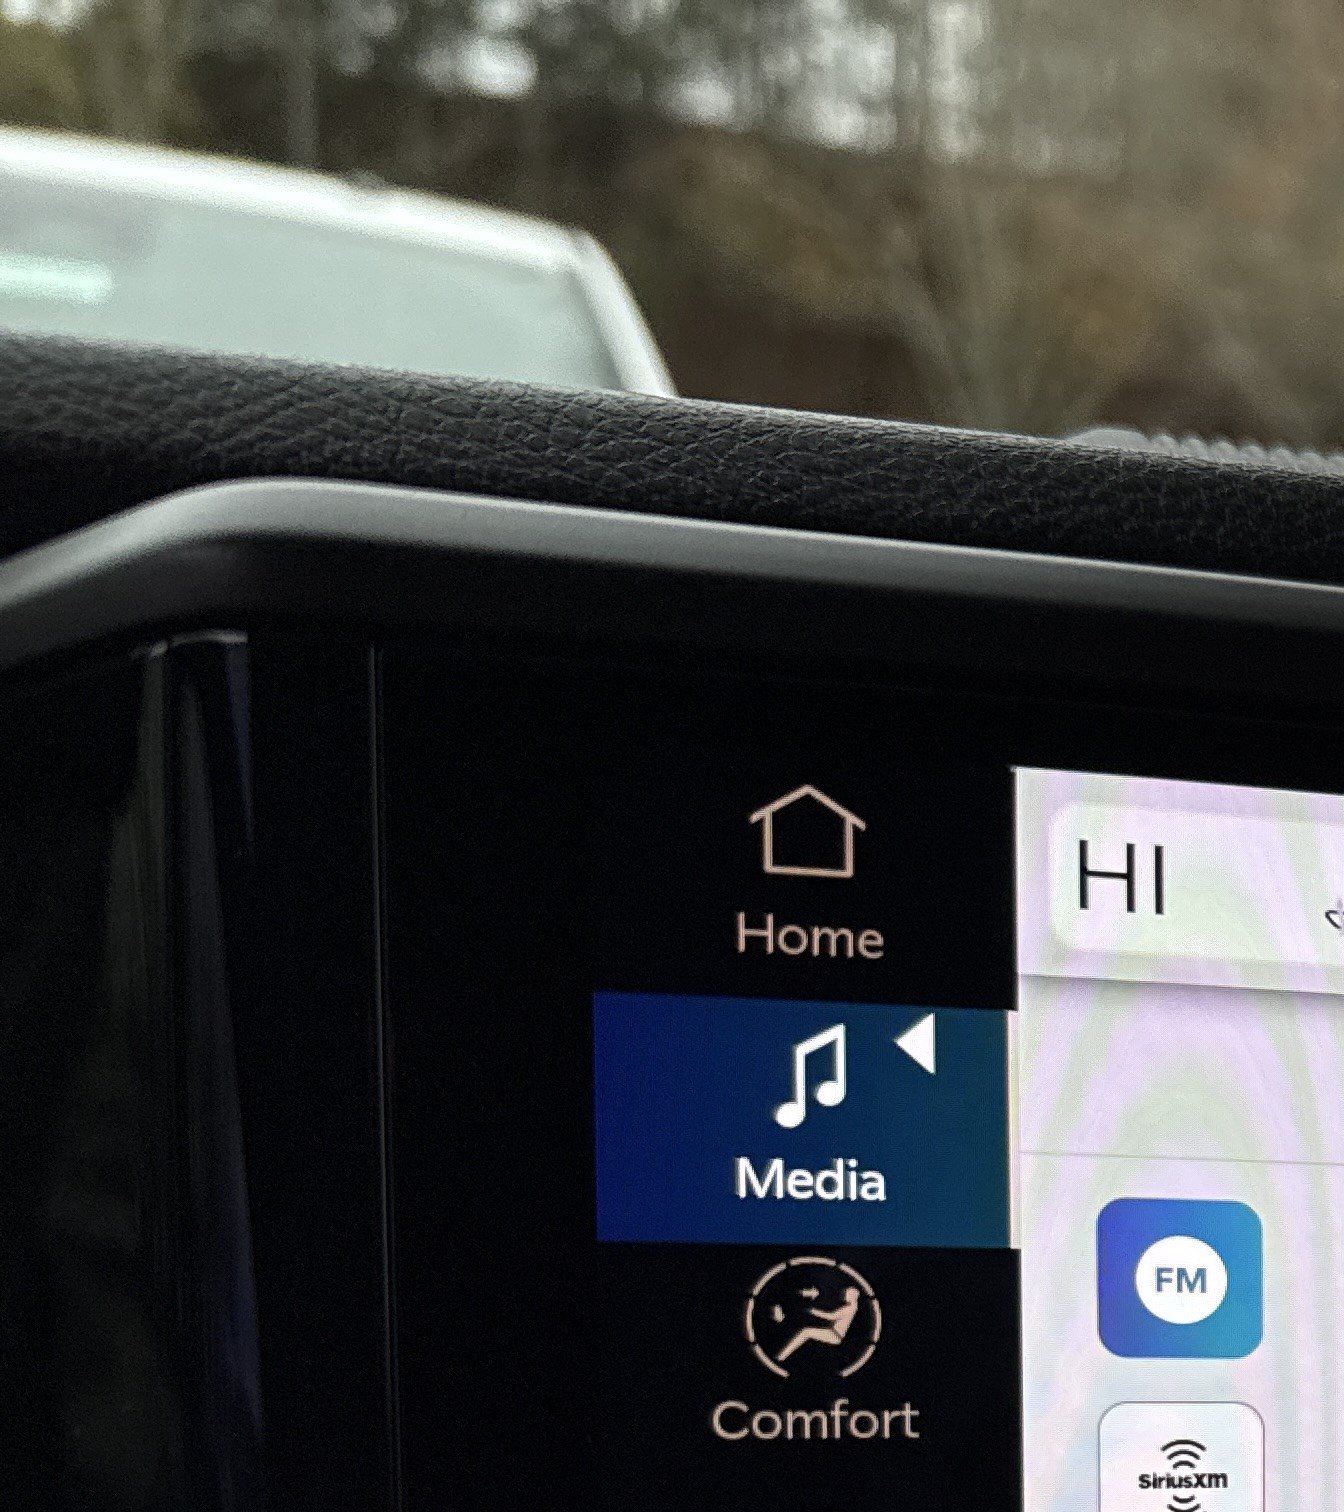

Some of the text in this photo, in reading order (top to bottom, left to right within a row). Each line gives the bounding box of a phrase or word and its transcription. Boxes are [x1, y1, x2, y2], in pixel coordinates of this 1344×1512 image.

[1080, 841, 1164, 915] HI
[739, 913, 884, 959] Home
[740, 1159, 886, 1201] Media
[1156, 1267, 1208, 1293] FM
[714, 1400, 920, 1440] Comfort
